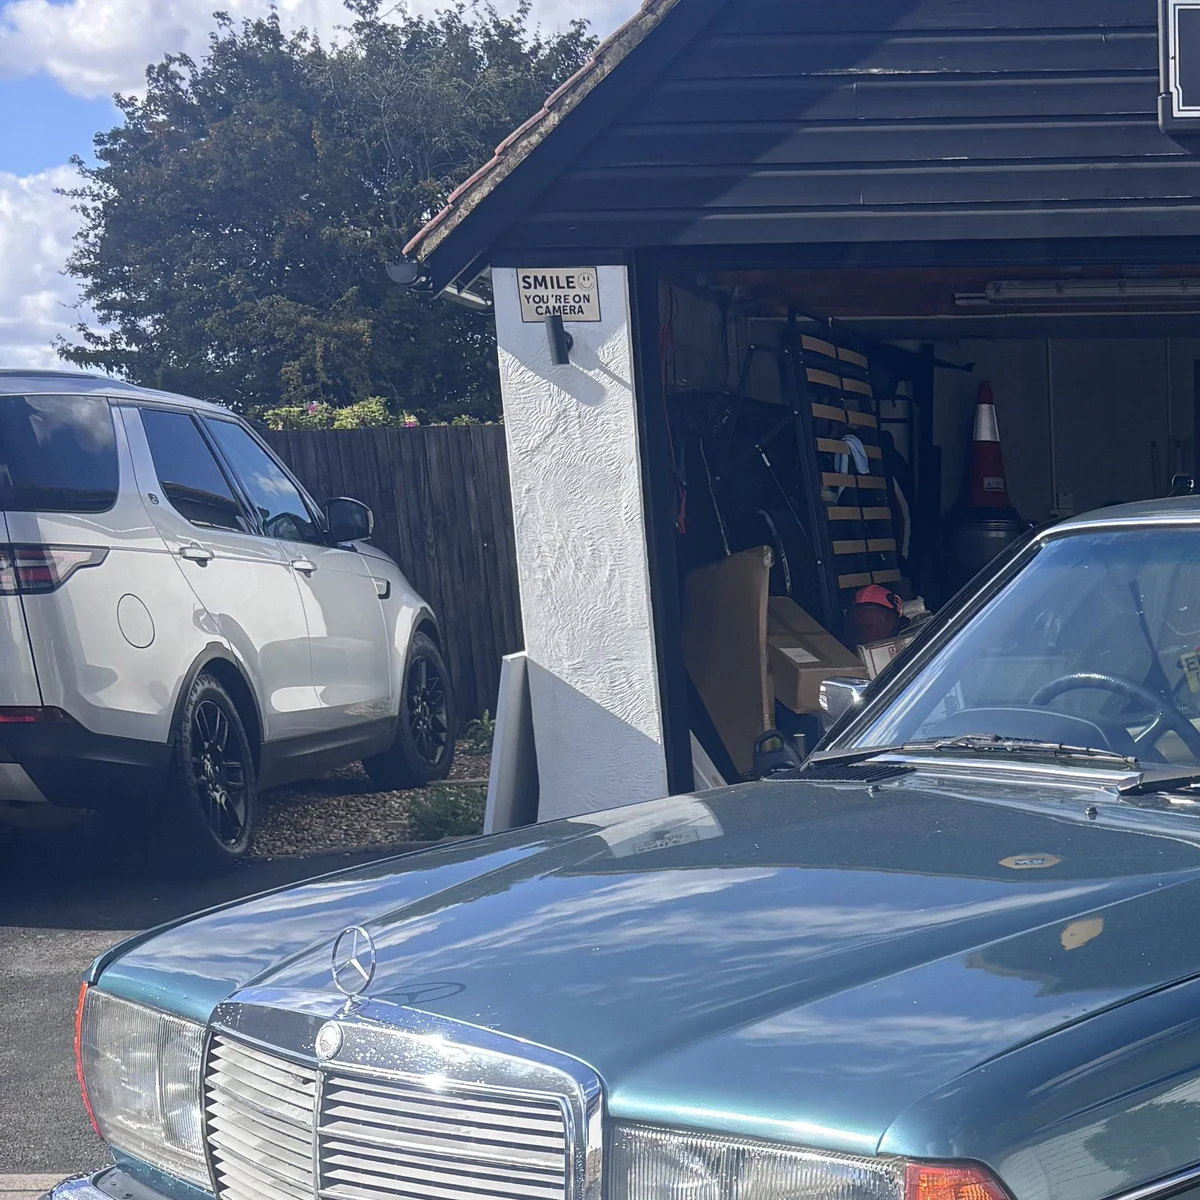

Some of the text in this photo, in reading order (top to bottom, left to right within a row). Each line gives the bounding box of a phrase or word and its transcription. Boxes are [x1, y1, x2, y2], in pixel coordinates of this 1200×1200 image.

[522, 275, 576, 290] SMILE
[524, 293, 591, 304] YOU'RE ON
[535, 304, 585, 316] CAMERA
